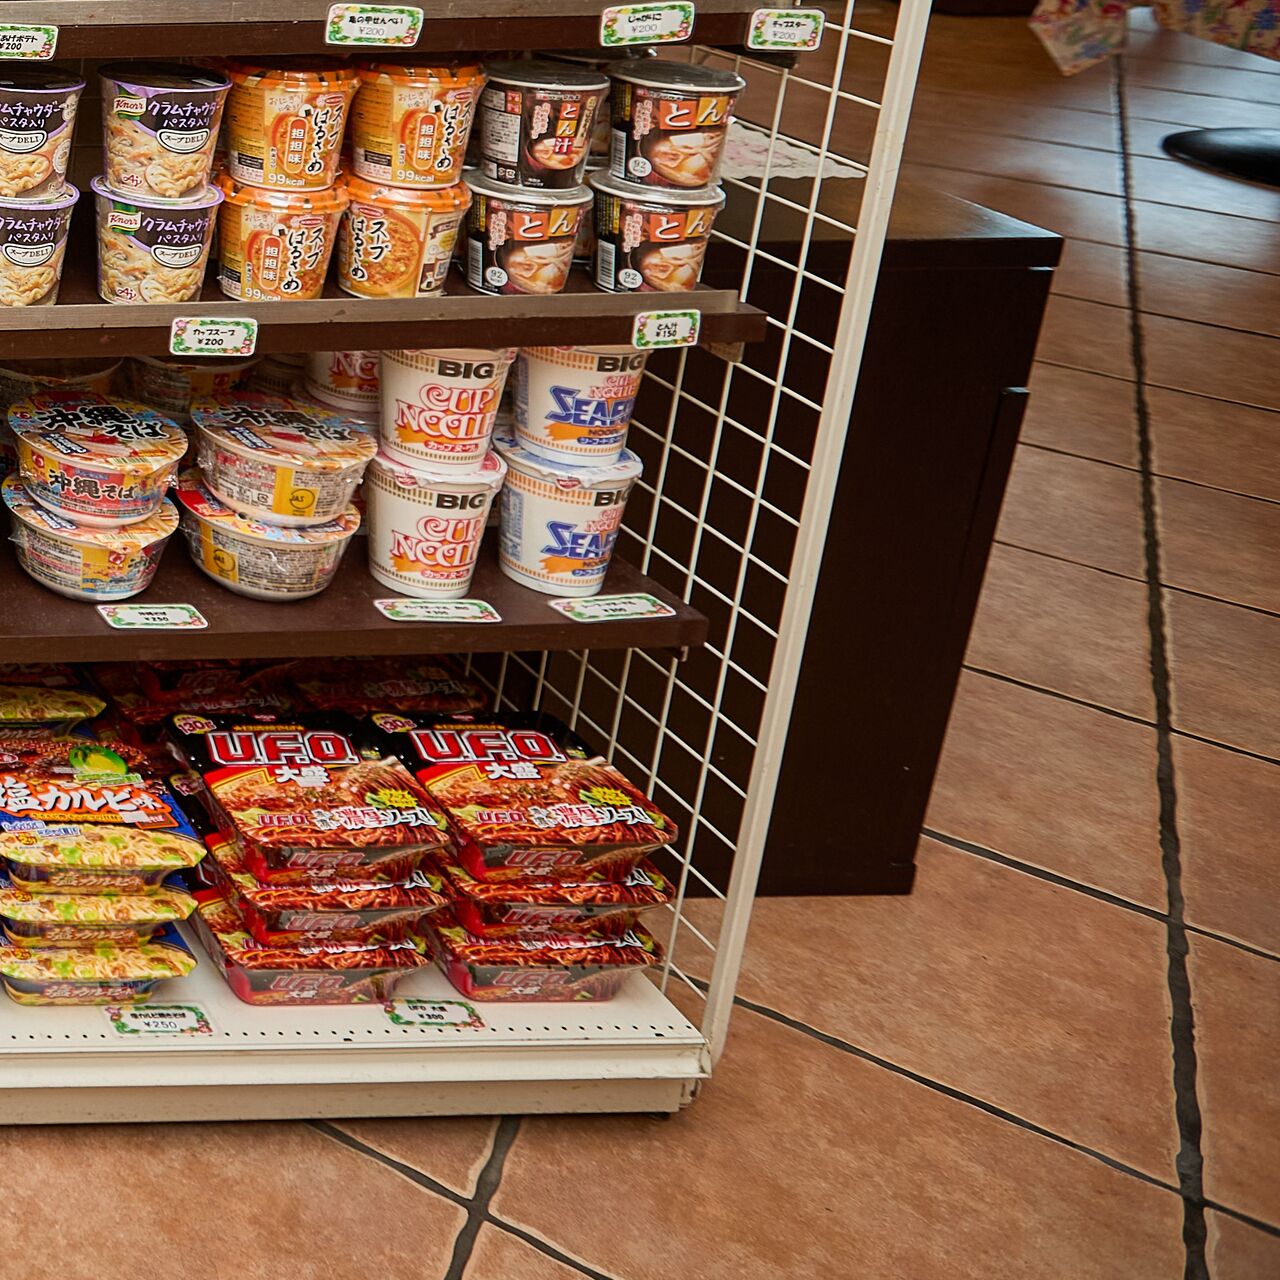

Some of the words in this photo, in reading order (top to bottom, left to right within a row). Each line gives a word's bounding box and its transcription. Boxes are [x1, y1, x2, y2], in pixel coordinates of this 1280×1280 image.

[348, 15, 403, 26] 亀の甲せんべい
[115, 99, 144, 111] Knorr
[163, 116, 209, 129] パスタ入り
[110, 213, 138, 225] Knorr
[8, 231, 54, 242] パスタ入り
[158, 233, 202, 244] パスタ入り
[192, 328, 236, 337] カップスープ
[438, 360, 495, 379] BIG
[597, 356, 643, 373] BIG
[419, 383, 496, 415] CUP
[394, 397, 494, 439] NOODLE
[48, 468, 138, 501] 沖縄そば
[437, 492, 486, 510] BIG
[208, 731, 359, 765] U.F.O.
[410, 729, 567, 763] U.F.O.
[487, 762, 541, 780] 大盛
[143, 1020, 177, 1029] ¥250
